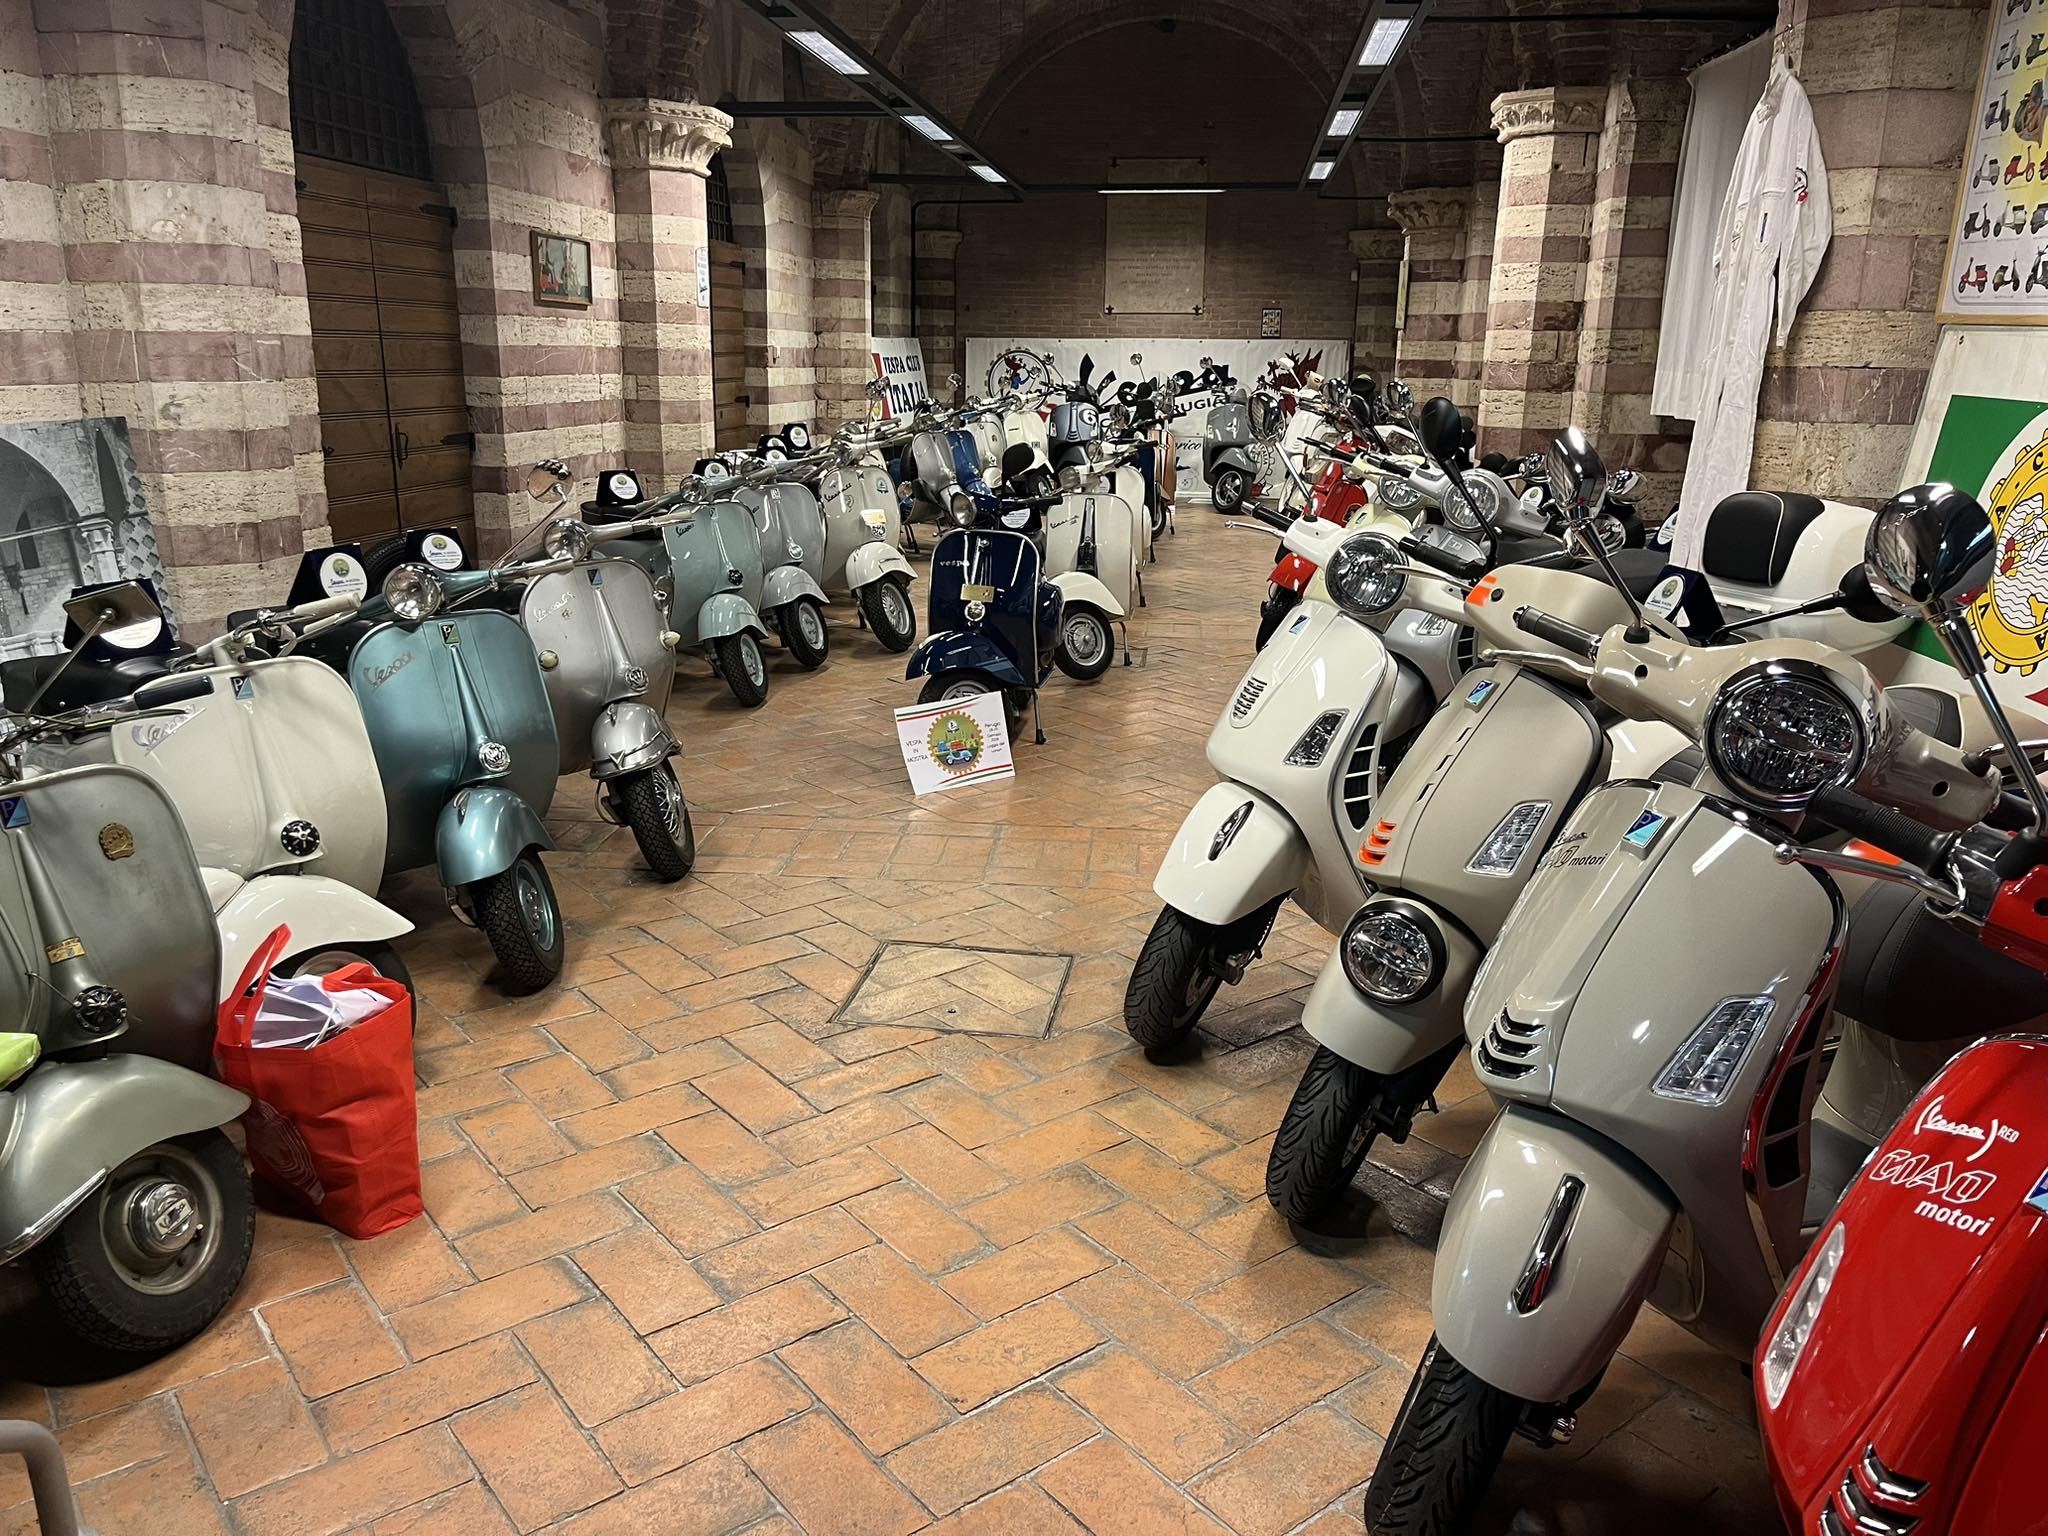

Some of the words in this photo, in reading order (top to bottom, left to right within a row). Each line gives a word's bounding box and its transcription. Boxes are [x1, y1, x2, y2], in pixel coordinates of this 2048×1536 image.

[883, 355, 906, 374] VESPA
[1172, 397, 1228, 415] RUGIA
[905, 739, 923, 747] VESPA
[907, 754, 929, 763] MOSTRA
[1567, 853, 1608, 867] motori
[1997, 1124, 2020, 1144] RED
[1868, 1149, 1997, 1204] CIAO
[1914, 1200, 1995, 1237] motori
